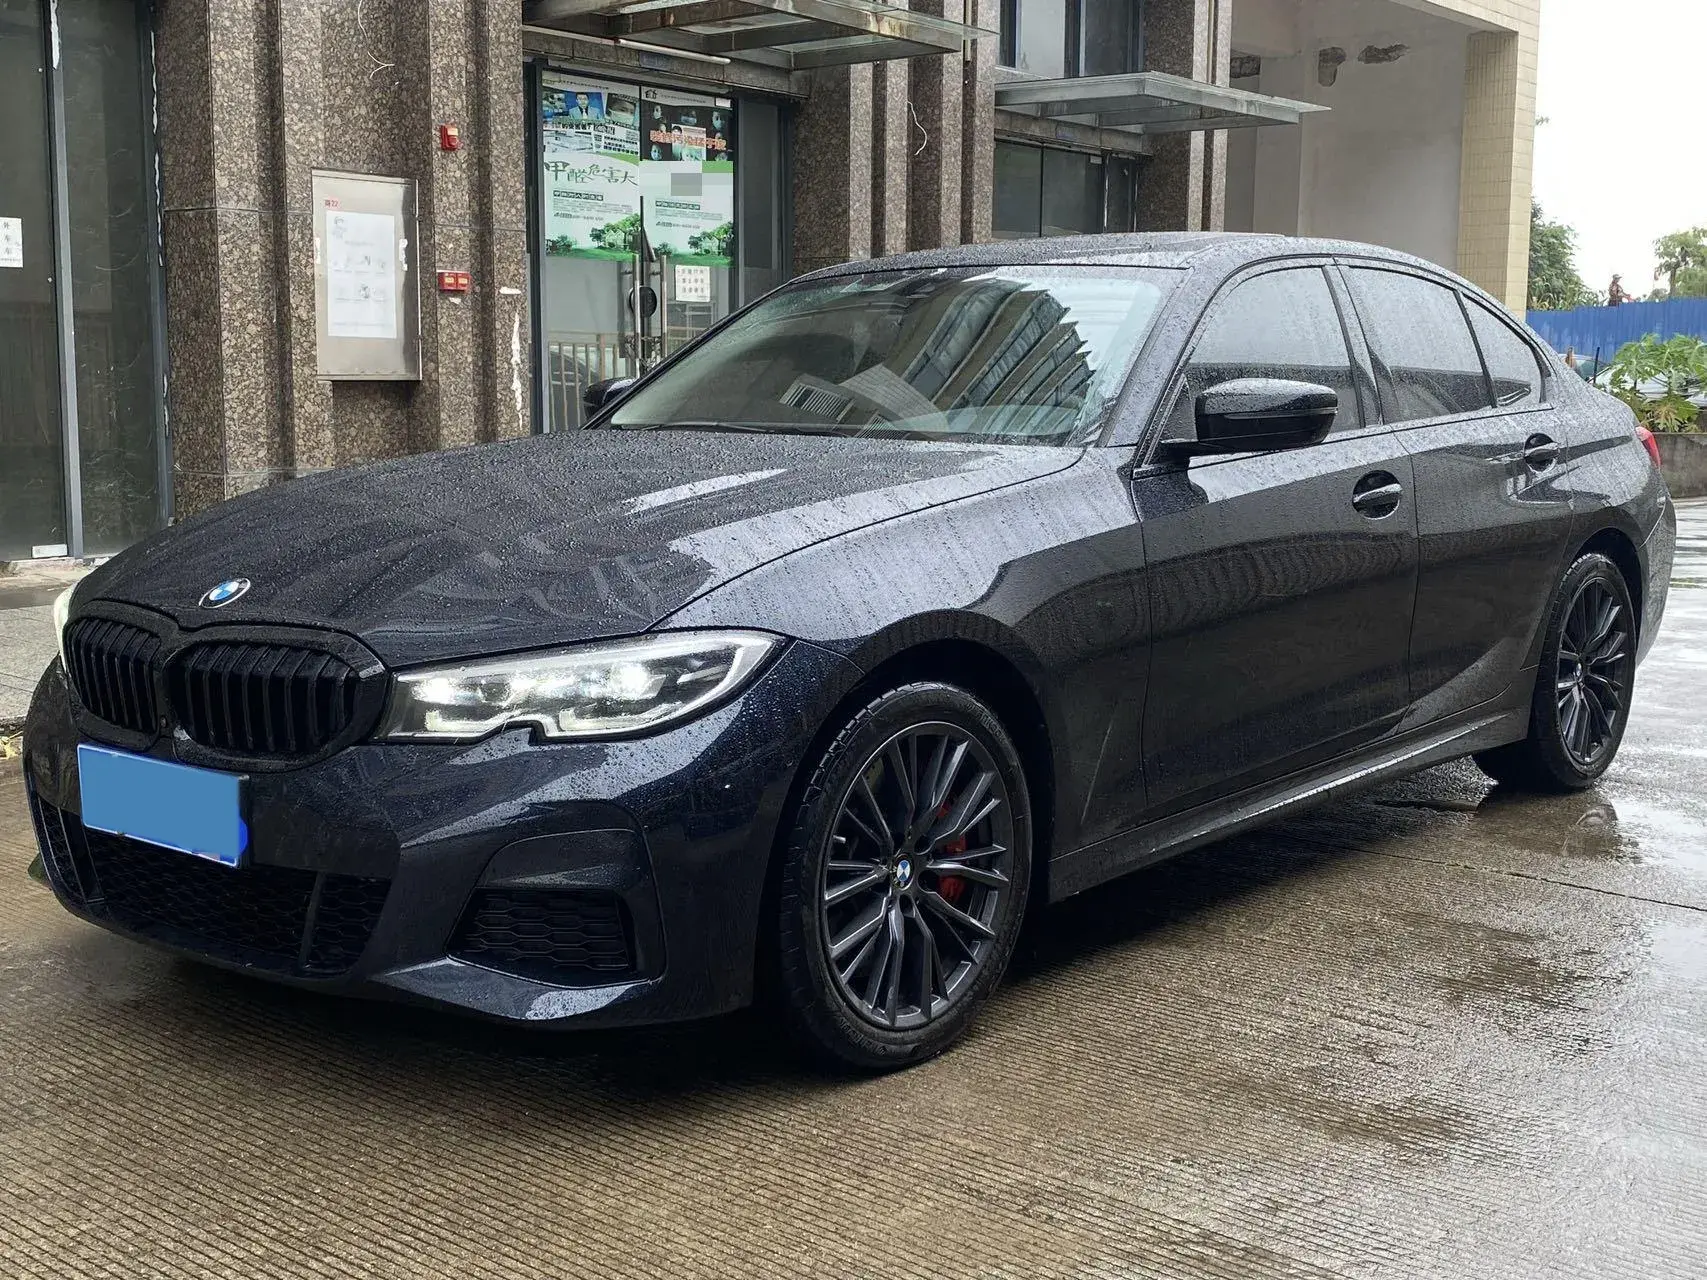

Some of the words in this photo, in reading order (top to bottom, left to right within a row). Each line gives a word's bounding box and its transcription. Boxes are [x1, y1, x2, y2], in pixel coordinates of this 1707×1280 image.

[544, 160, 639, 186] 甲醛危害大
